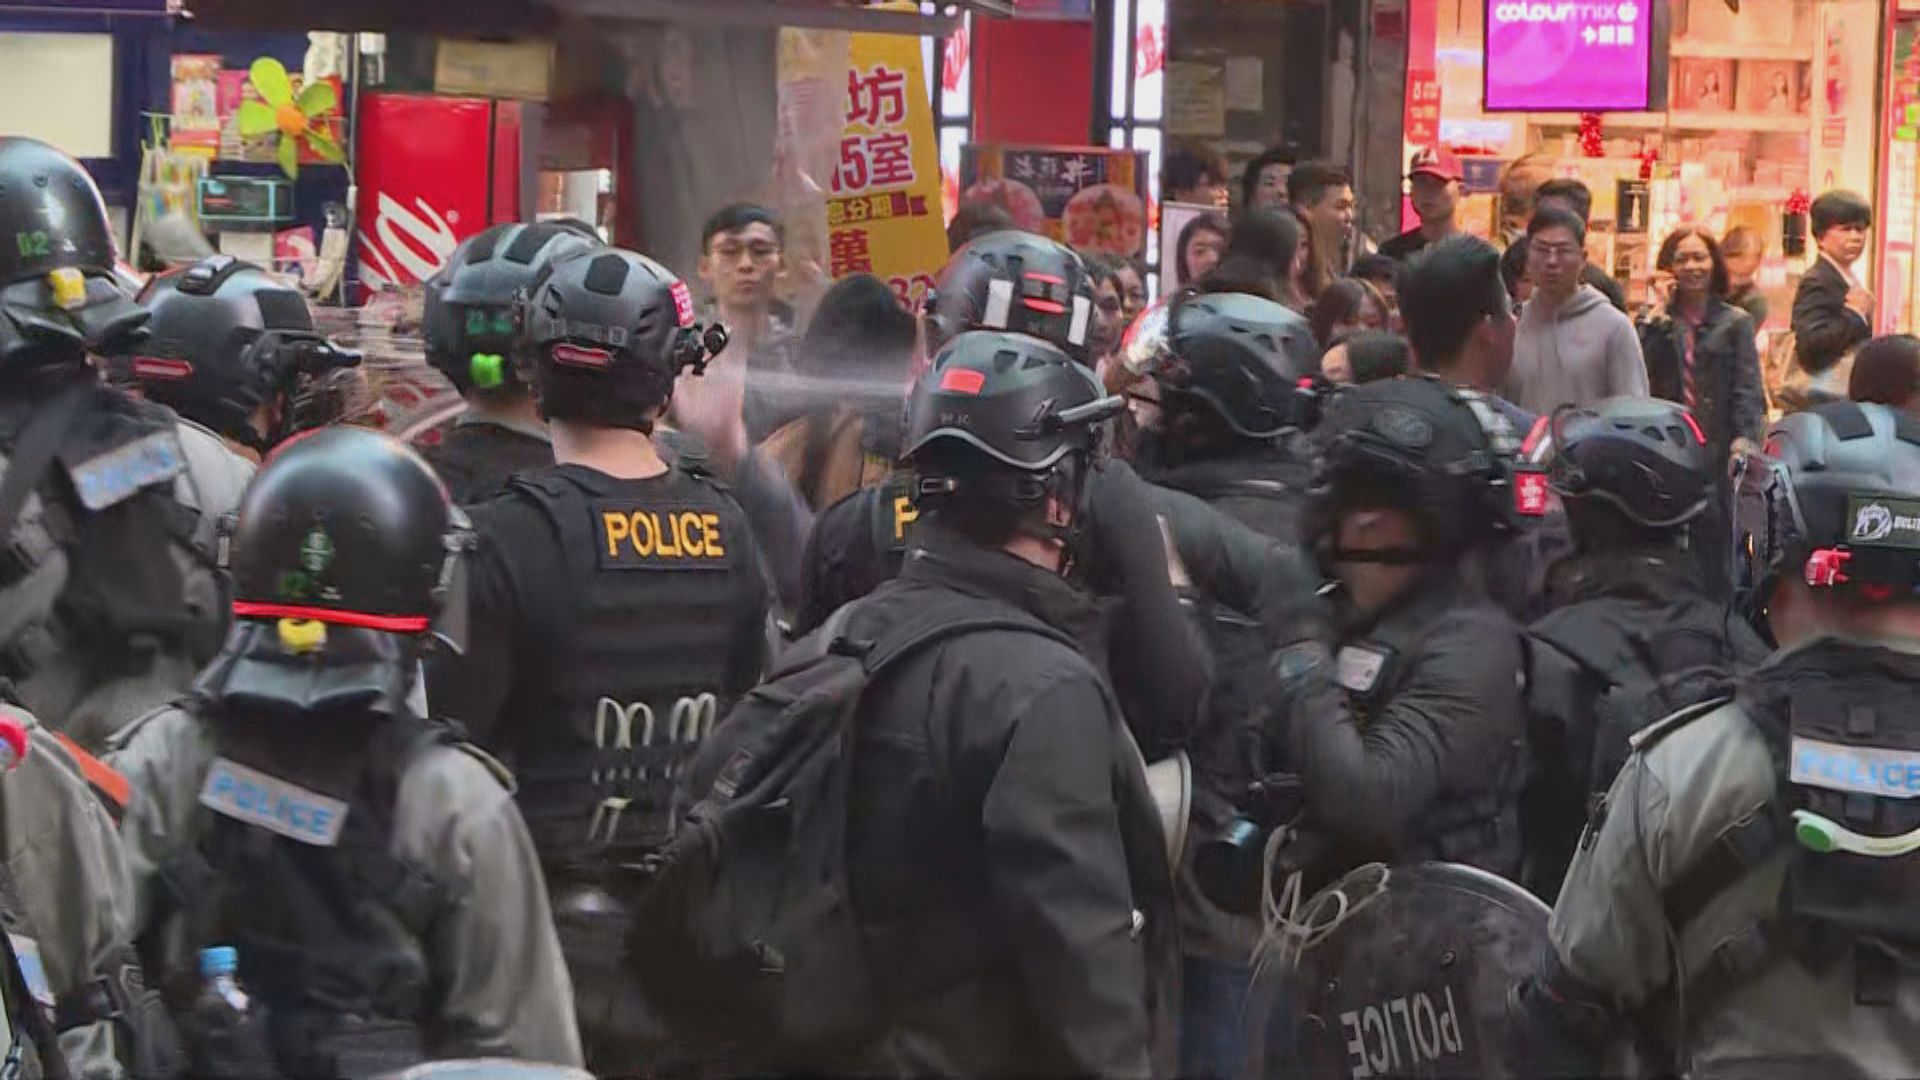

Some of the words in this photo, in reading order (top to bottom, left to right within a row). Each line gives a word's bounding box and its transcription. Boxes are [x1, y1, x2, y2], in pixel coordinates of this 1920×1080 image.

[603, 511, 724, 558] POLICE
[213, 772, 334, 837] POLICE
[1340, 985, 1463, 1079] POLICE
